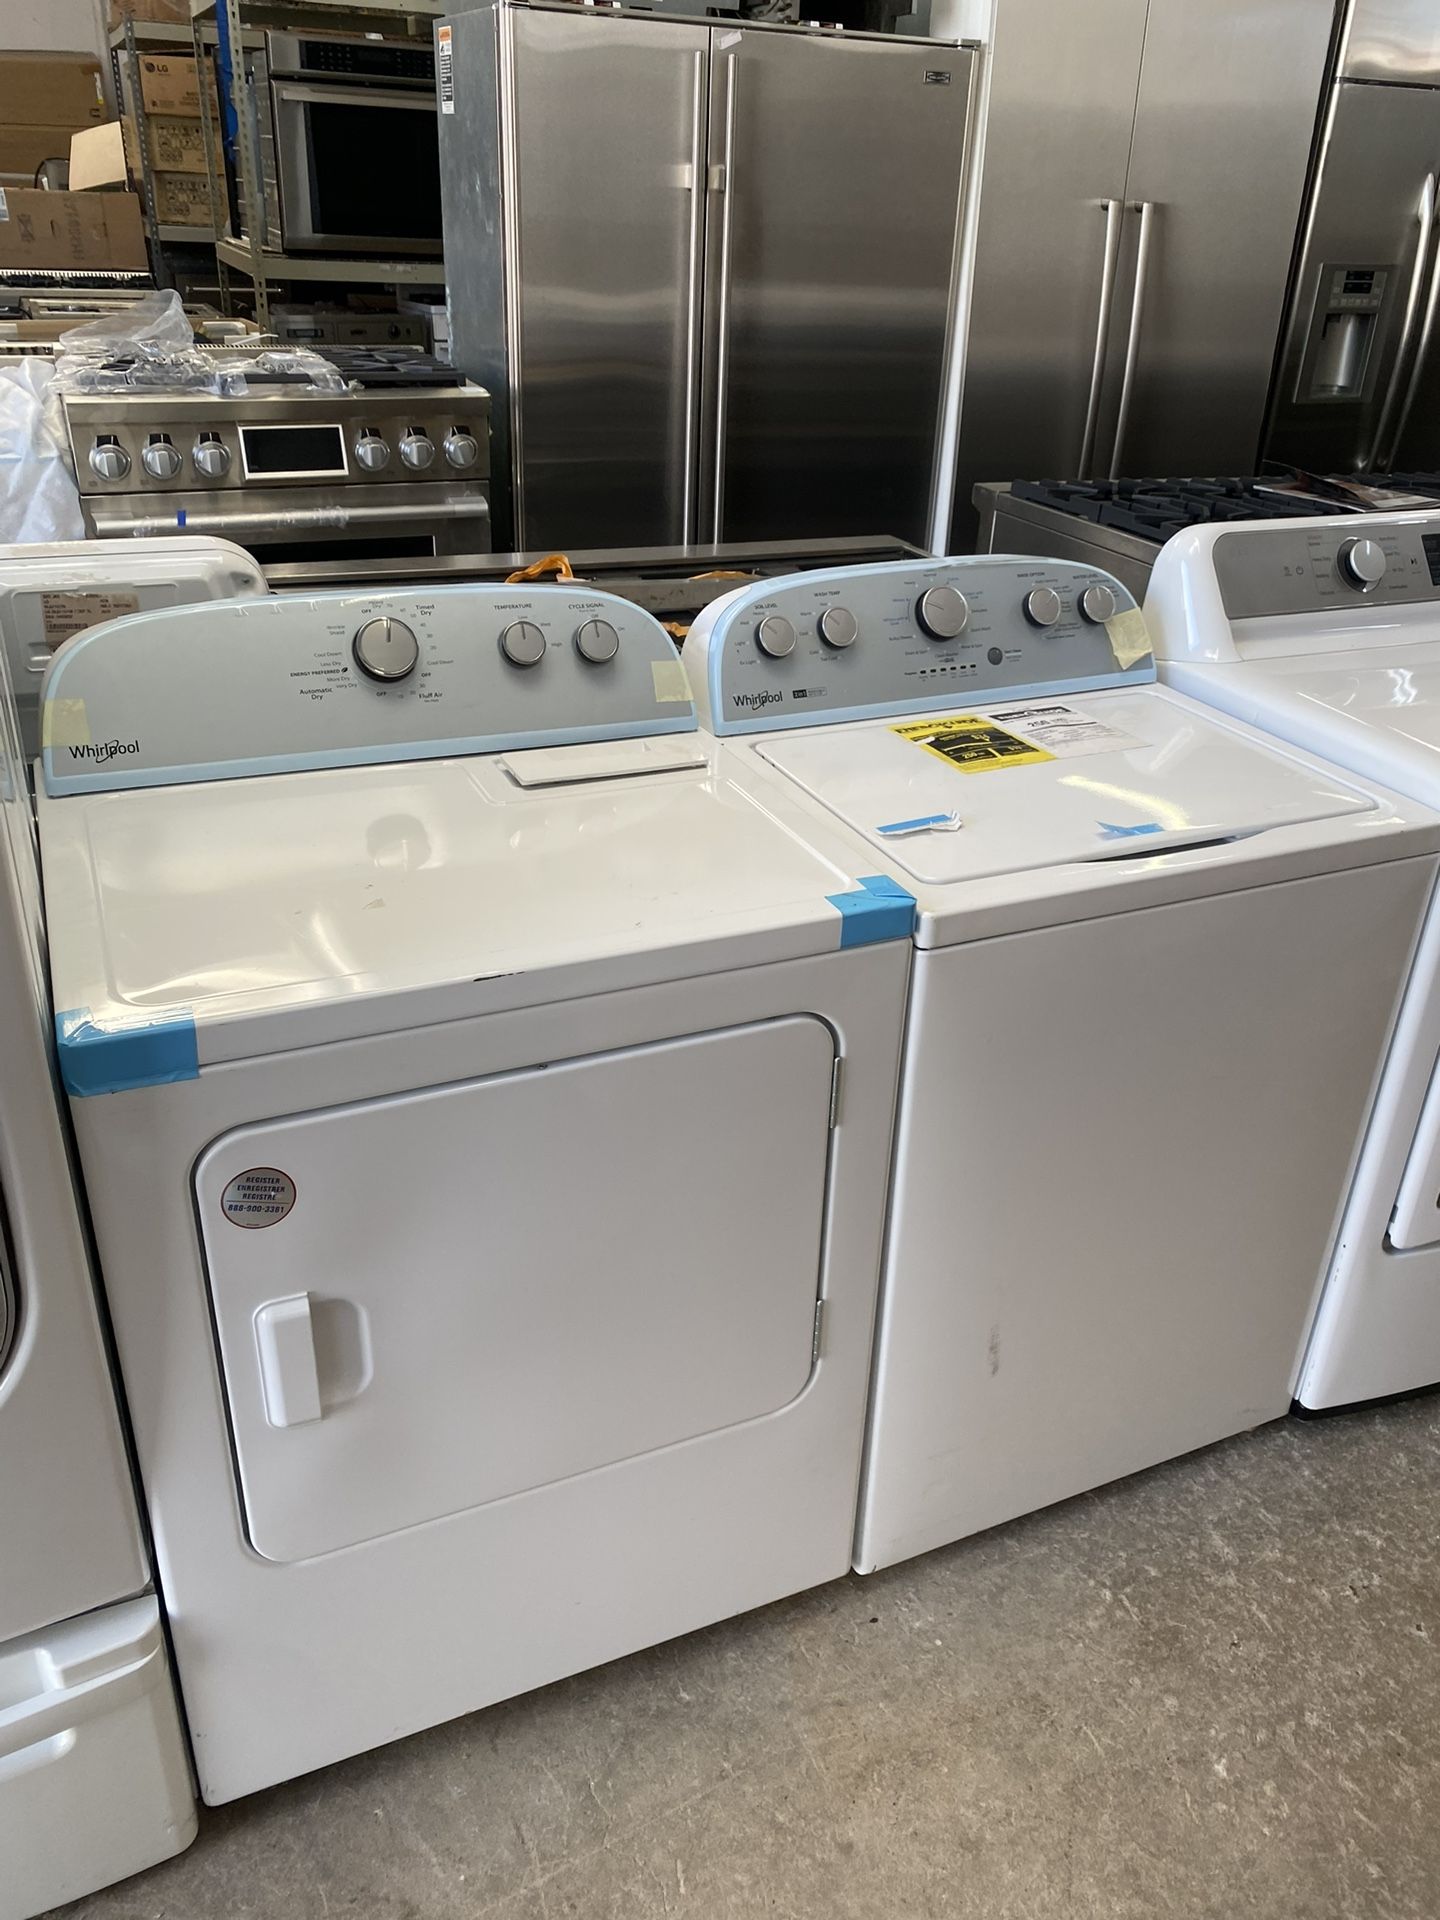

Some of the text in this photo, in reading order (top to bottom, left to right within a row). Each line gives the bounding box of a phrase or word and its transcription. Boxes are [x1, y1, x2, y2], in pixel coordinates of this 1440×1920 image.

[156, 64, 169, 73] LG
[732, 690, 783, 711] Whirlpool
[68, 739, 140, 763] Whirlpool
[246, 1176, 281, 1184] REGISTER
[237, 1184, 286, 1193] ENREGISTRER
[242, 1193, 277, 1201] REGISTRE
